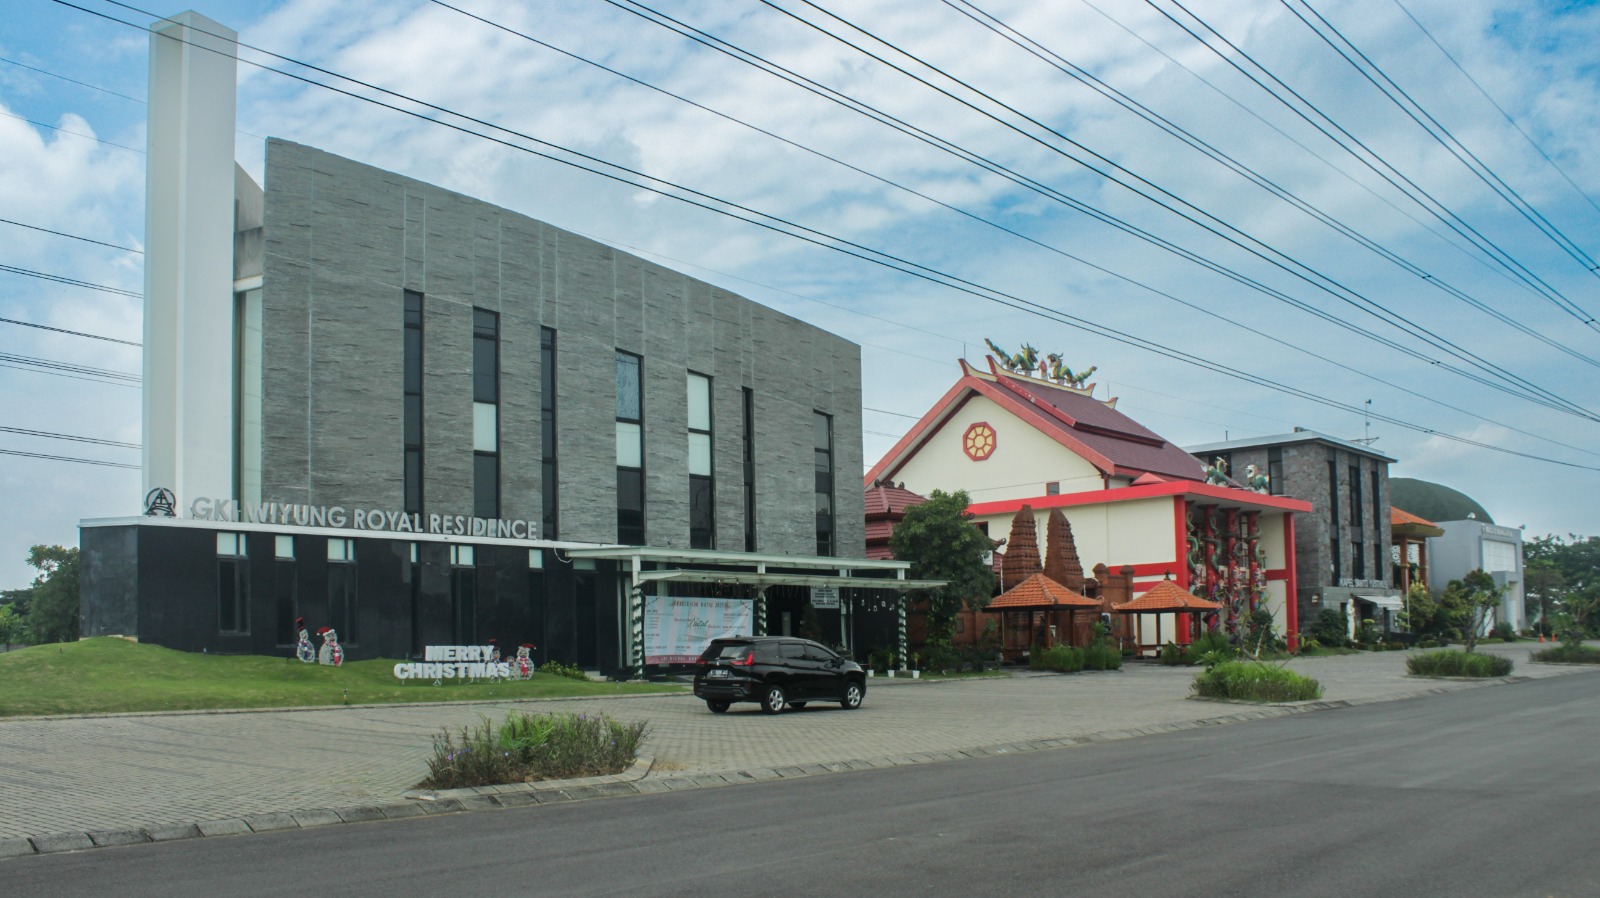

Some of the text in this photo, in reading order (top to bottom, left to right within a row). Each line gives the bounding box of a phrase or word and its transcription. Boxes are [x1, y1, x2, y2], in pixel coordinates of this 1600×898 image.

[191, 496, 538, 540] GKI WIYUNG ROYAL RESIDENCE
[424, 645, 495, 662] MERRY
[393, 662, 510, 680] CHRISTMAS
